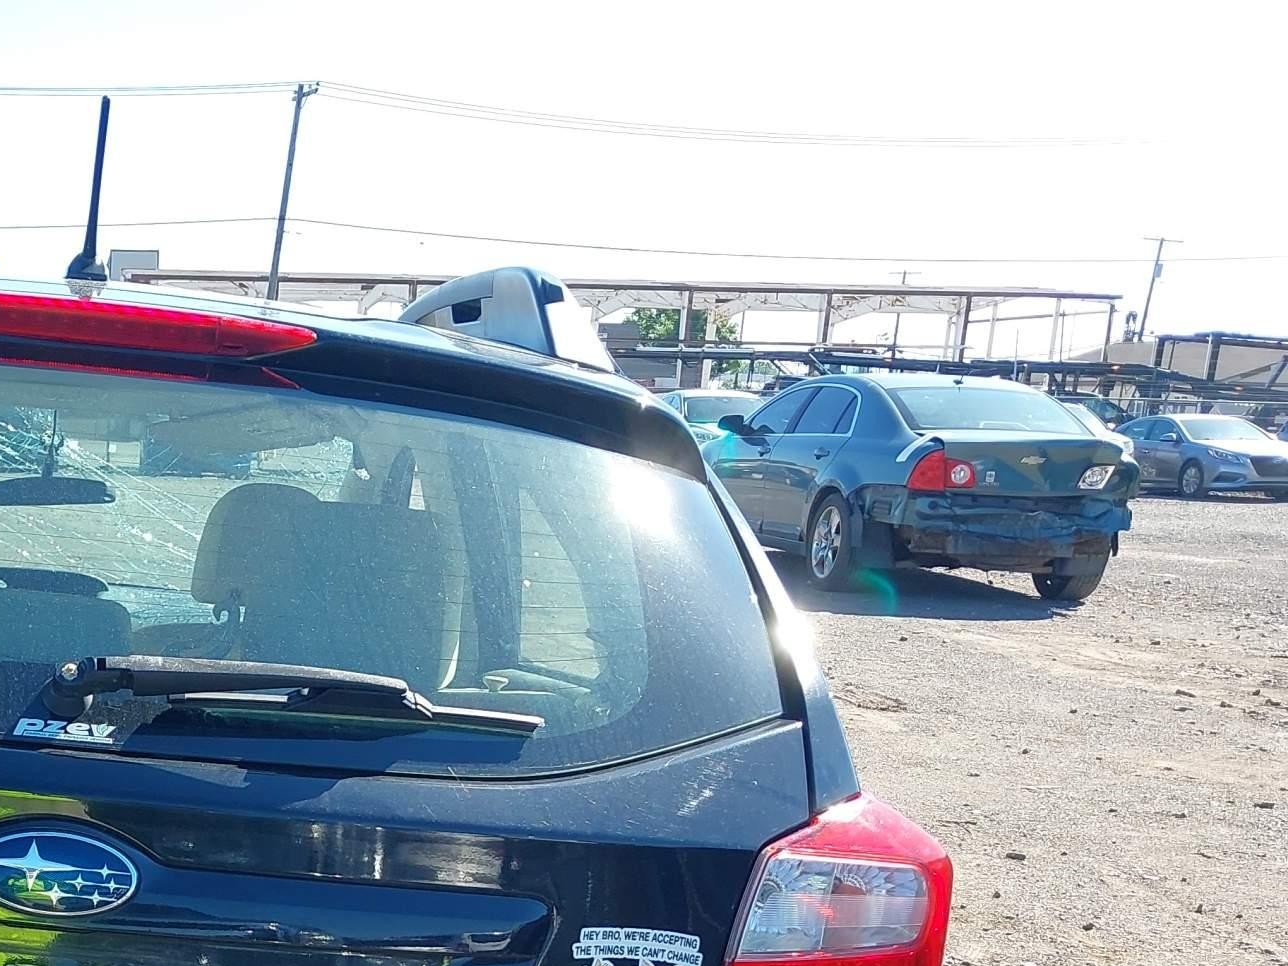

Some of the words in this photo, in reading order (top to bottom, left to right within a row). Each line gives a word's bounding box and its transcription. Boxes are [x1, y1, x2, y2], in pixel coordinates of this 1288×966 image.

[13, 718, 117, 737] pzev
[582, 931, 601, 942] HEY
[602, 931, 622, 943] BRO,
[623, 931, 651, 943] WE'RE
[651, 934, 698, 951] ACCEPTING
[575, 945, 592, 957] THE
[594, 945, 625, 957] THINGS
[627, 946, 639, 957] WE
[641, 947, 666, 959] CAN'T
[667, 950, 701, 966] CHANGE
